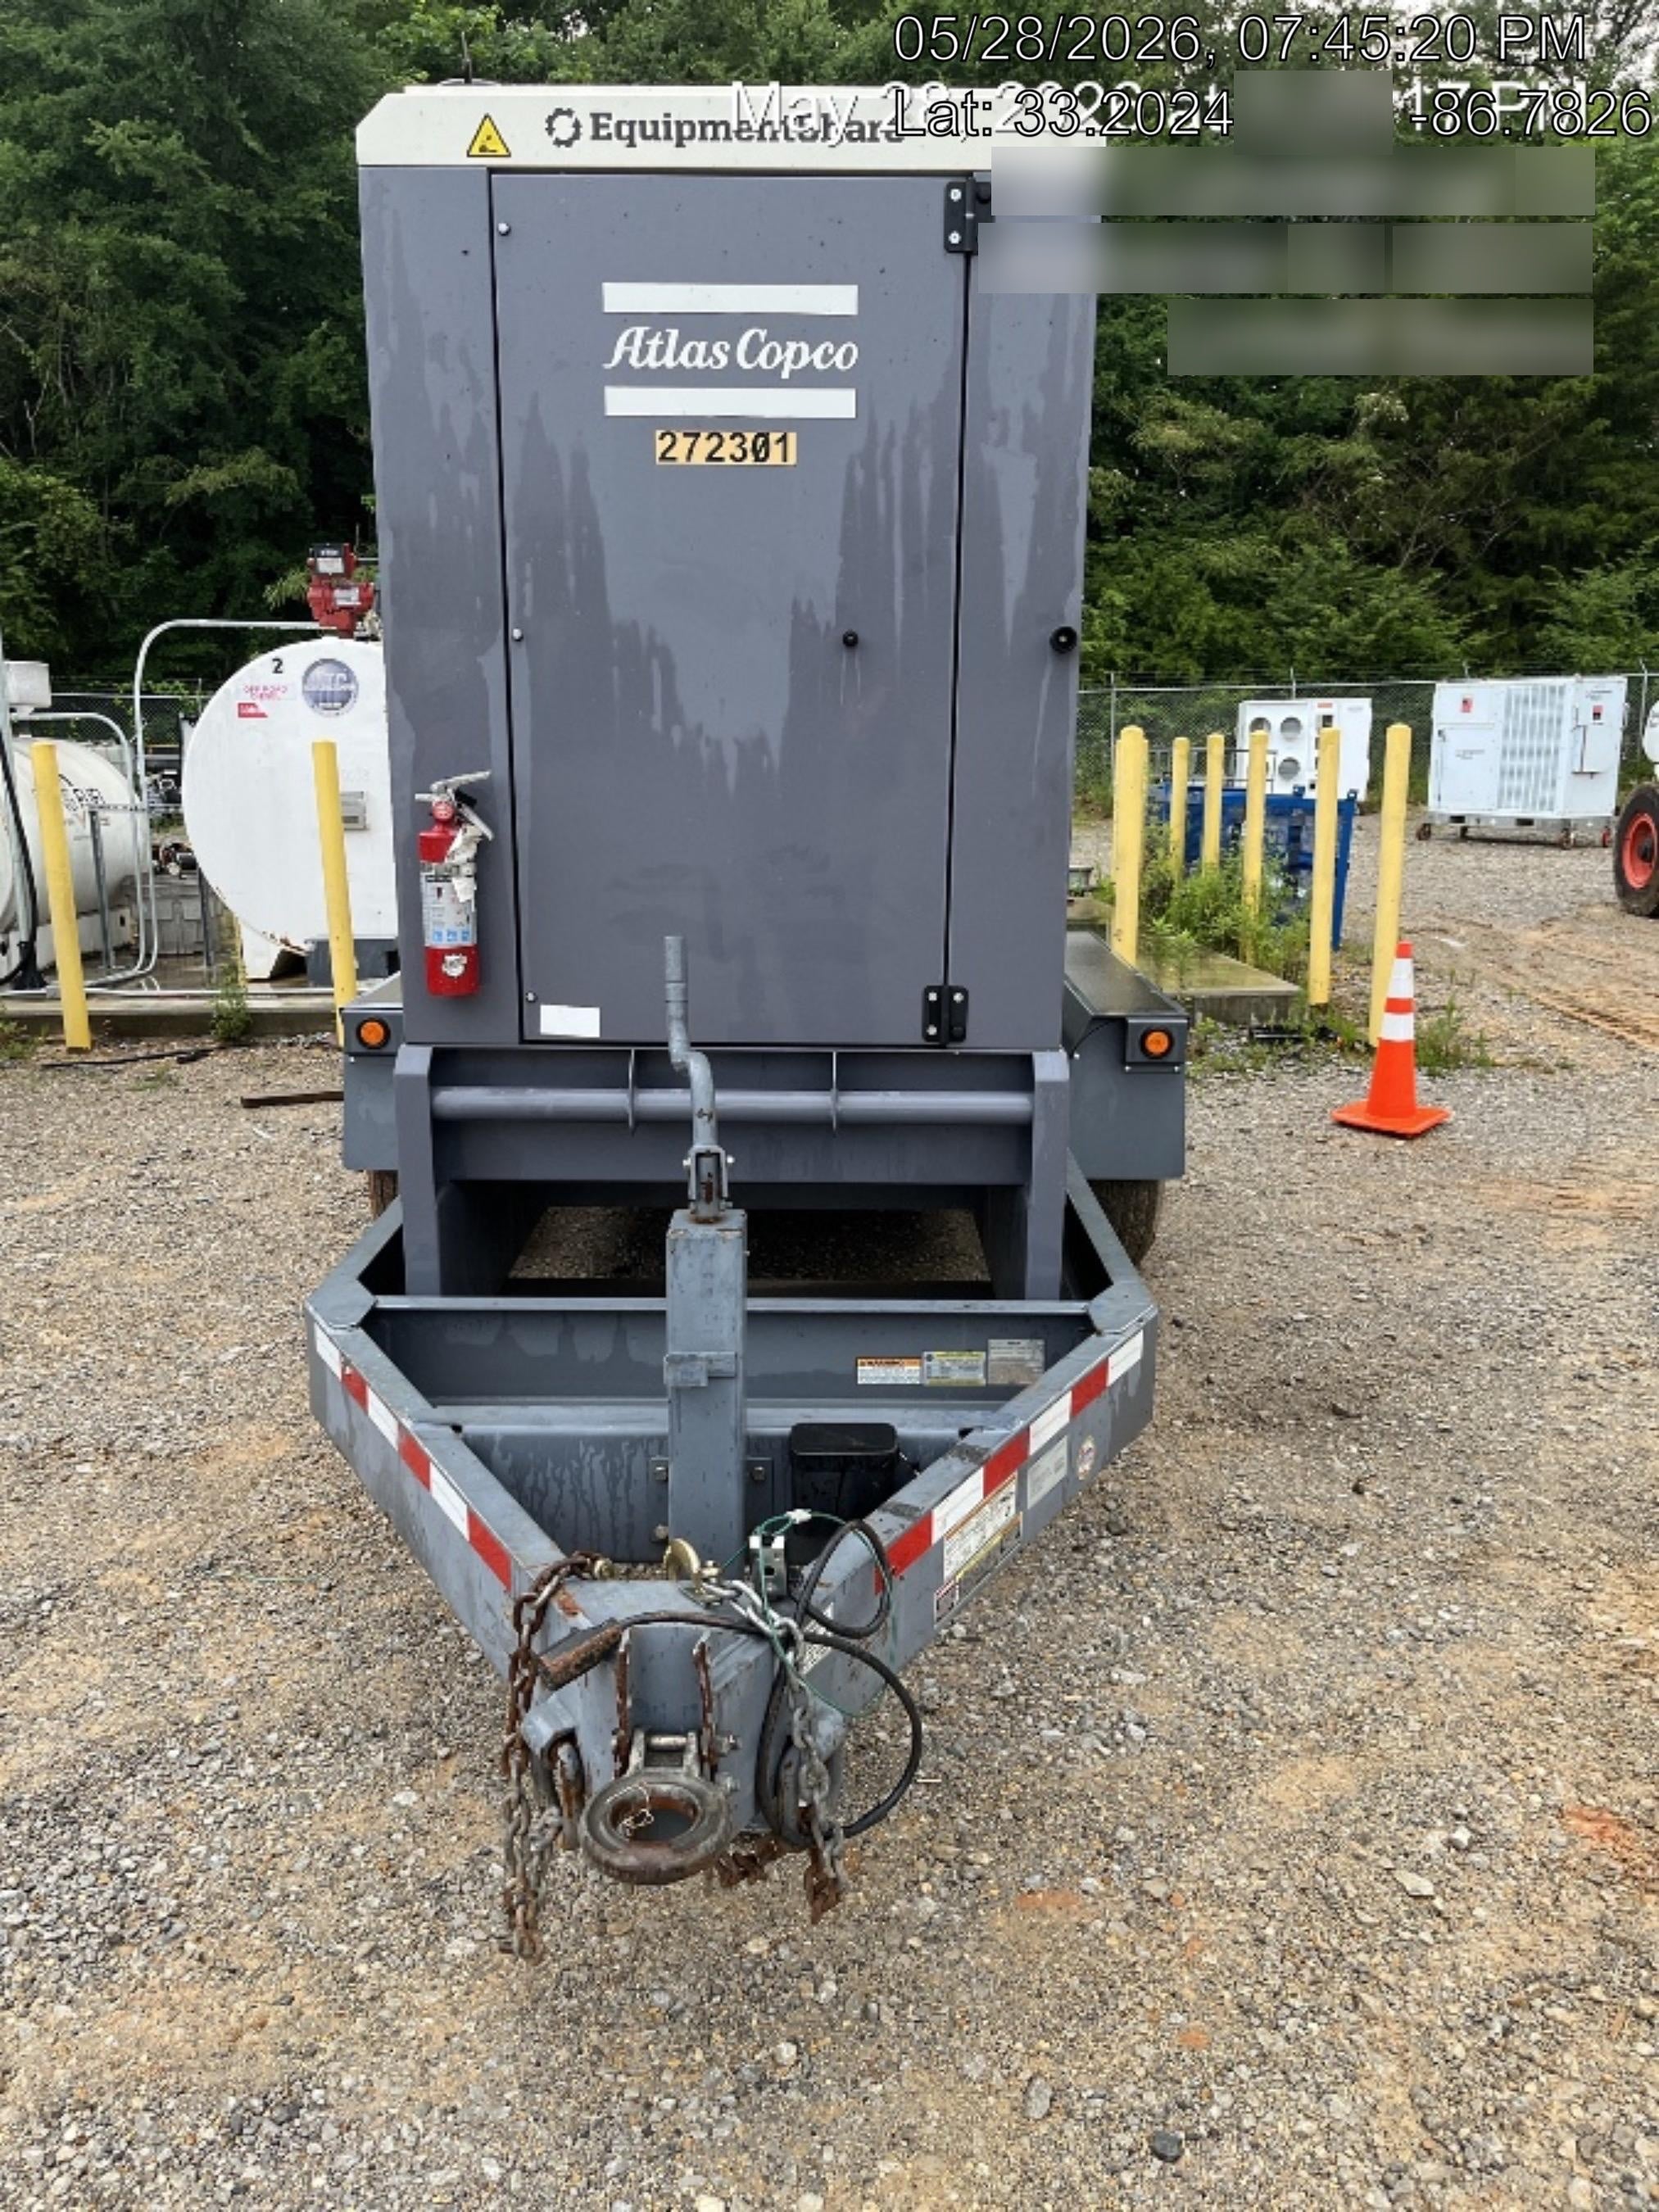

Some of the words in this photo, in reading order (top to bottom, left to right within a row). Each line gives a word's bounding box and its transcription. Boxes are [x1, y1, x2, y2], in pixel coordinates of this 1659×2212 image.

[601, 326, 732, 369] Atlas
[736, 327, 859, 379] Copco
[658, 432, 790, 463] 272301
[271, 657, 283, 674] 2
